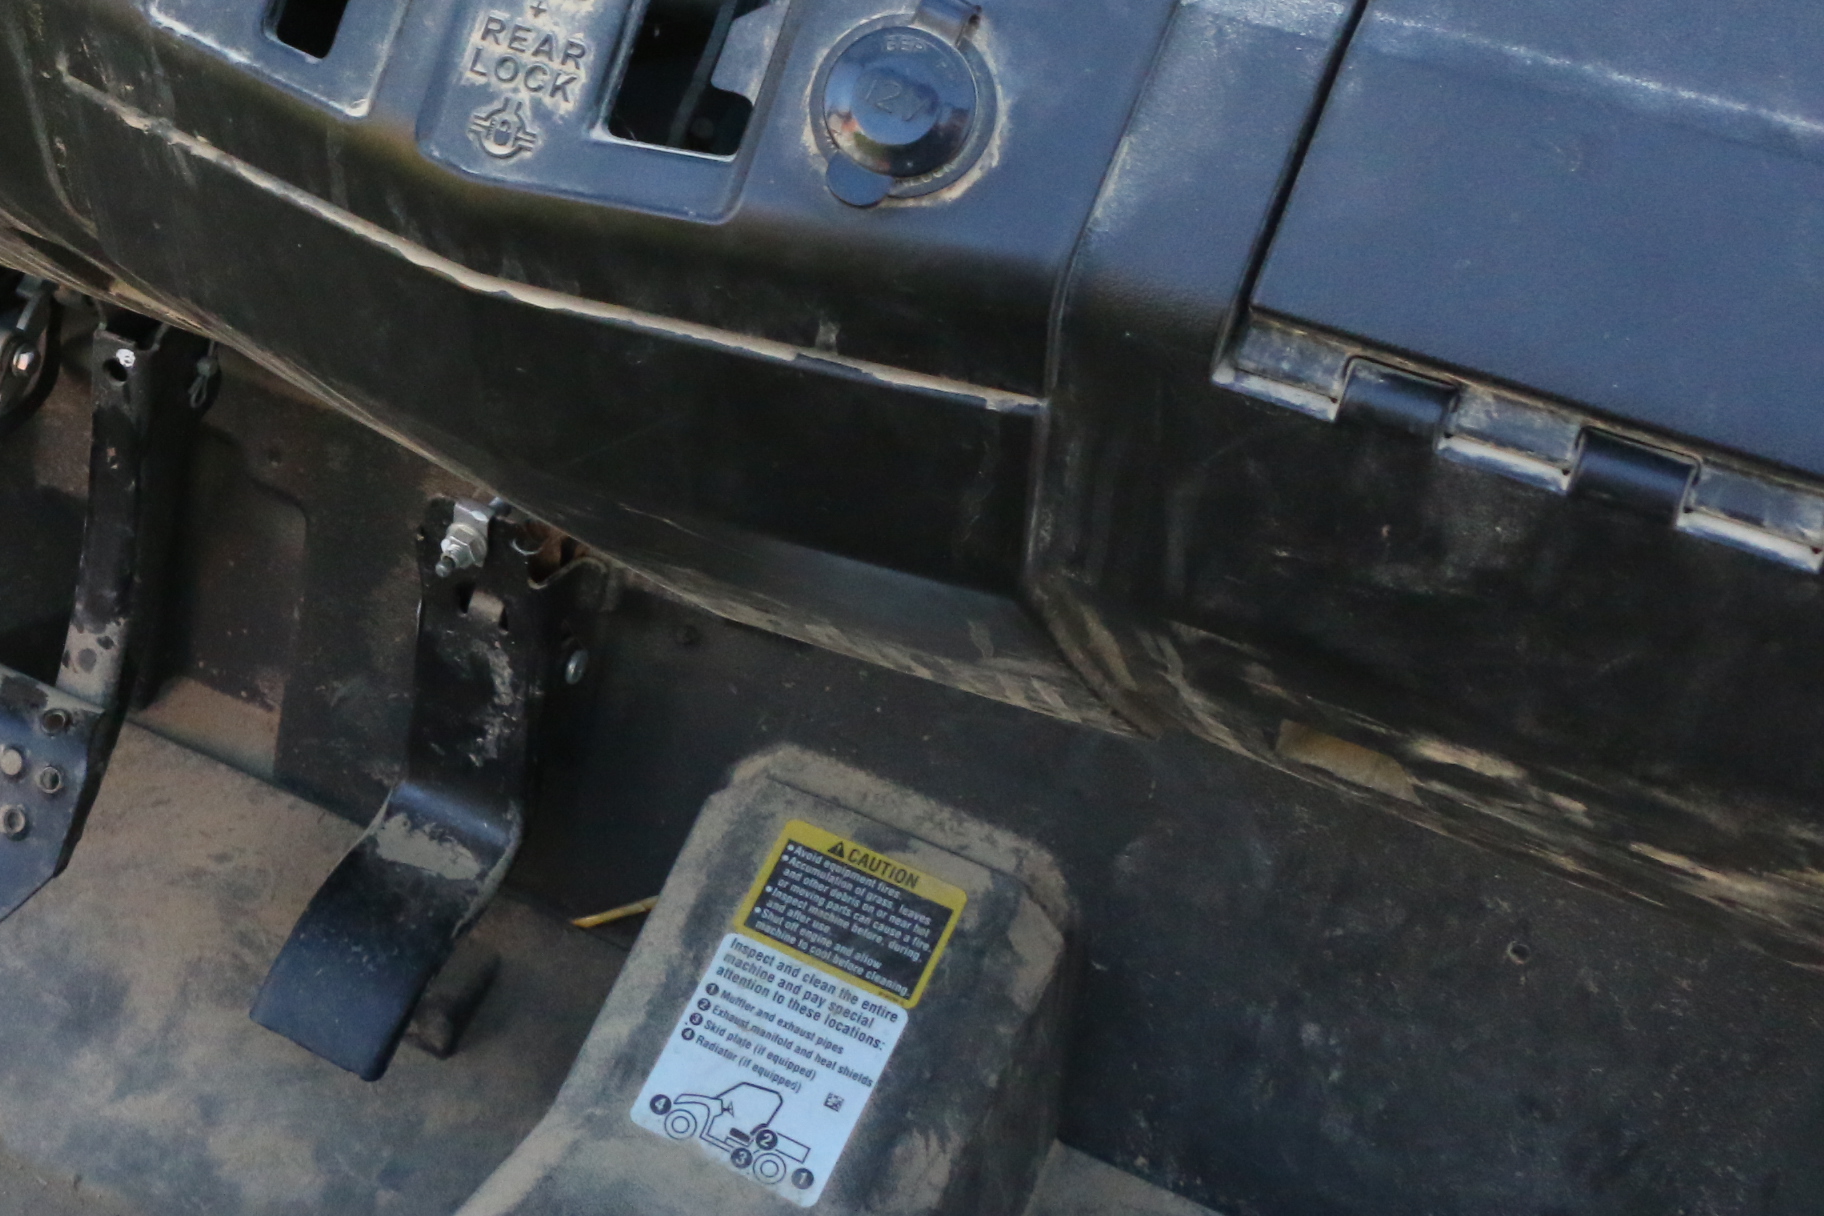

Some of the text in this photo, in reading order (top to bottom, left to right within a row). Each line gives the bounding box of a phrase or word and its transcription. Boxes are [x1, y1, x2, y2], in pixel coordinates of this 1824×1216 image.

[479, 16, 588, 70] REAR
[469, 46, 579, 105] LOCK
[782, 868, 802, 880] and
[802, 877, 828, 892] other
[829, 887, 860, 906] debris
[788, 856, 931, 924] Accumulation leaves
[794, 845, 876, 887] Avoid equipment
[847, 848, 920, 889] CAUTION
[772, 887, 807, 909] Inspect
[786, 909, 810, 924] after
[789, 884, 901, 938] moving parts cause
[761, 908, 881, 969] Shut off engine allow
[716, 966, 884, 1050] attention to these locations:
[723, 953, 874, 1027] machine and pay special
[730, 938, 775, 965] Inspect
[776, 961, 801, 977] and
[801, 973, 836, 994] clean
[838, 987, 858, 1004] the
[861, 1000, 898, 1022] entire
[704, 1020, 817, 1081] Skid plate equipped)
[712, 1005, 873, 1086] Exhaust manifold and heat shields
[720, 990, 843, 1054] Muffler and exhaust pipes
[695, 1035, 802, 1093] Radiator equipped)
